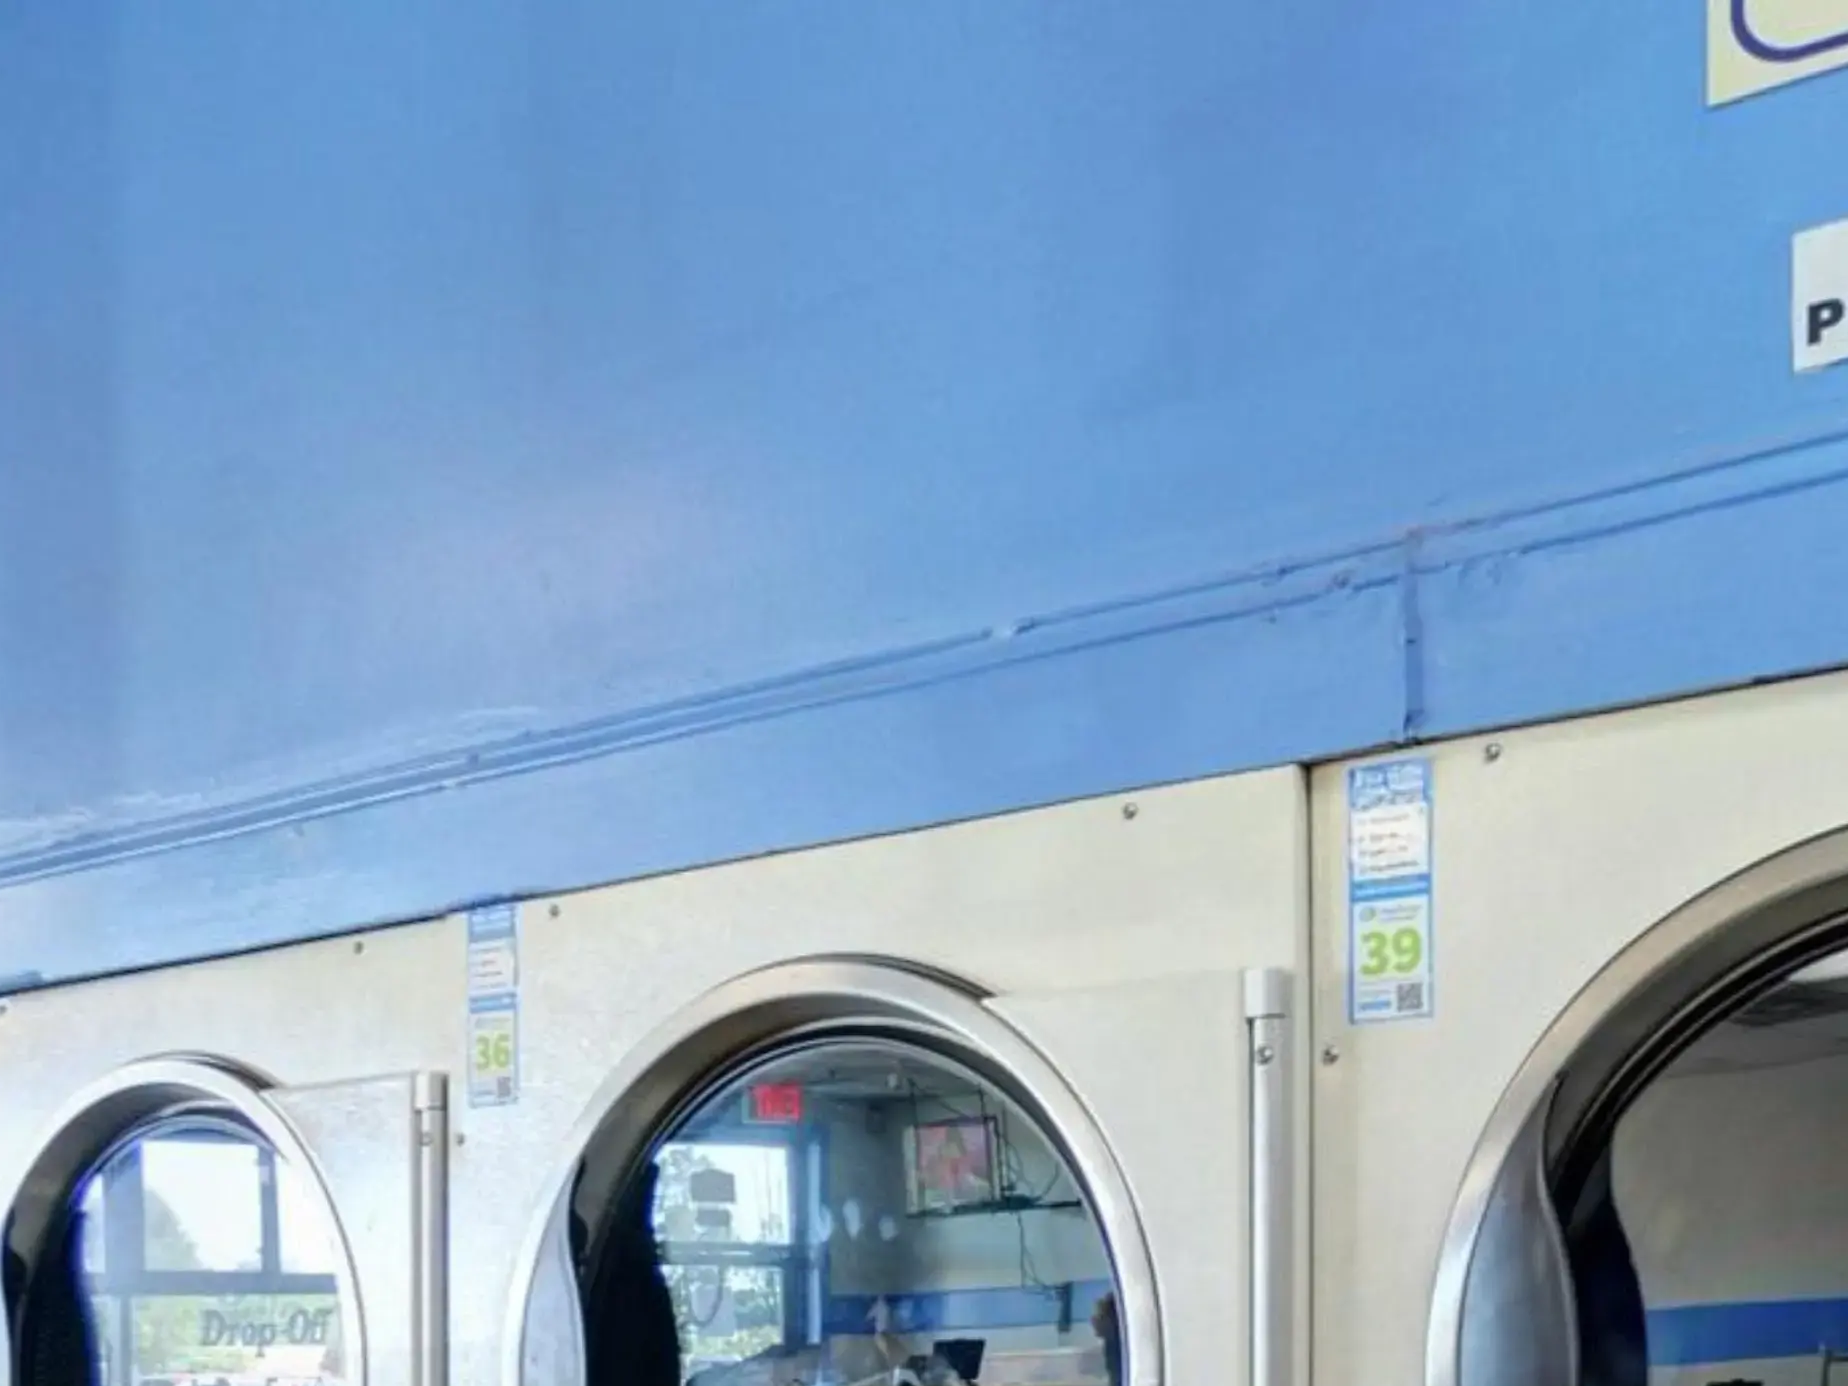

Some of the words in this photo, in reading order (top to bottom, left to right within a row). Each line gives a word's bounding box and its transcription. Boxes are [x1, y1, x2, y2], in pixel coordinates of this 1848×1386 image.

[1360, 927, 1422, 975] 39
[476, 1034, 510, 1071] 36
[200, 1307, 332, 1357] Drop-Off
